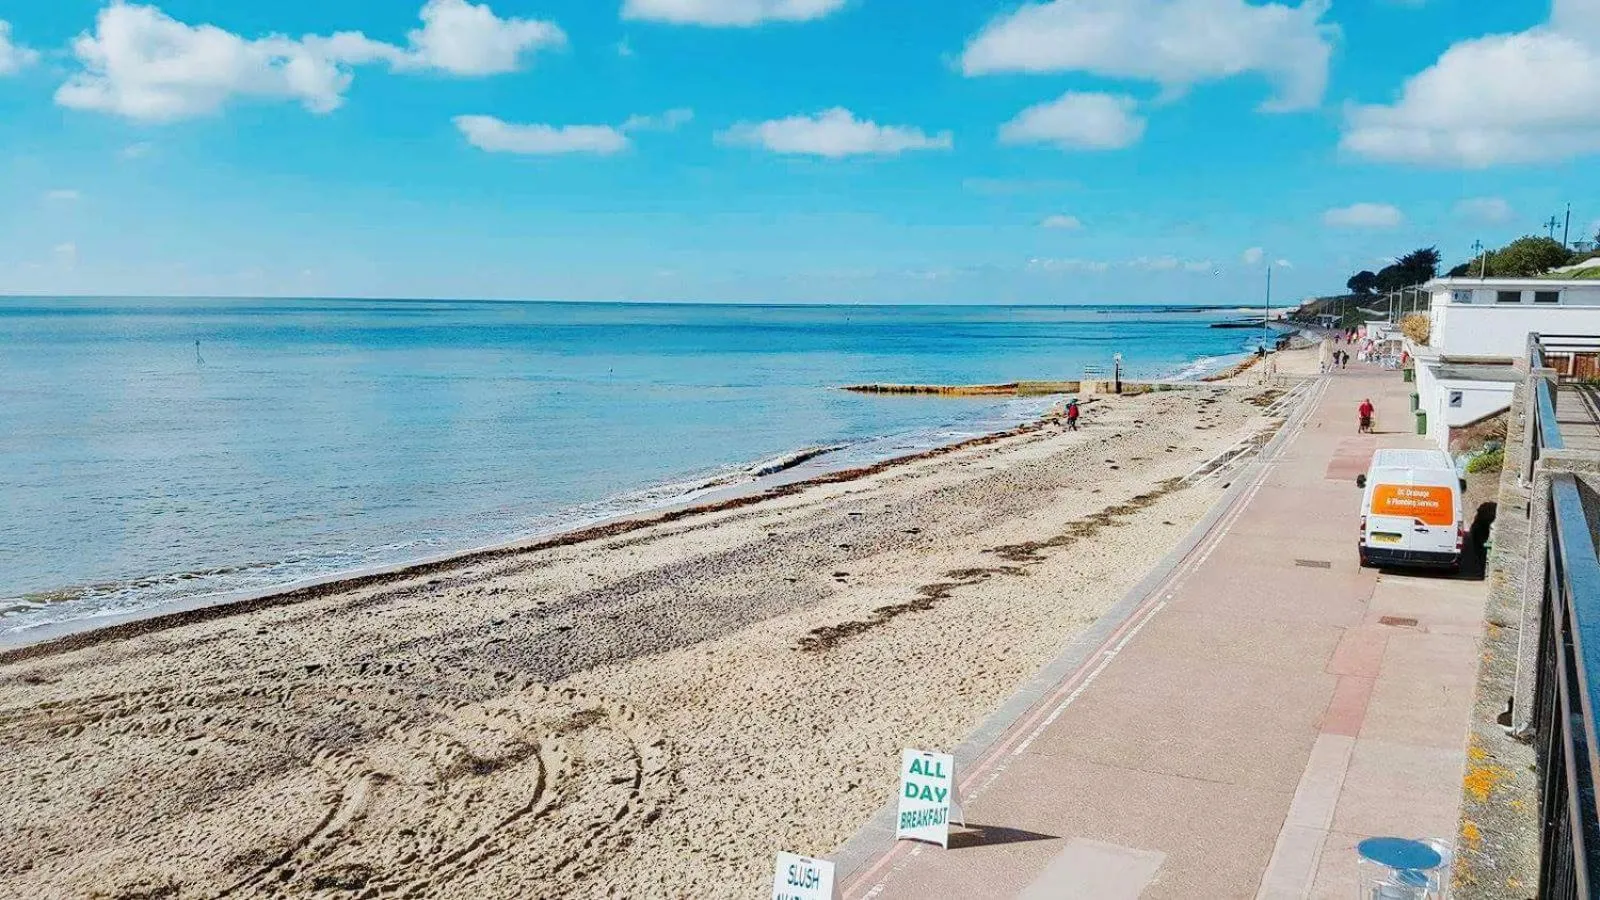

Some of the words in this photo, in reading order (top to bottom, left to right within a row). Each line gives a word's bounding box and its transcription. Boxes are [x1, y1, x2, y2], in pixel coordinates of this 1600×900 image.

[1391, 499, 1415, 507] Plumbing
[1416, 500, 1439, 508] Services
[909, 758, 946, 779] ALL
[904, 782, 948, 803] DAY
[900, 807, 948, 830] BREAKFAST
[787, 864, 821, 891] SLUSH
